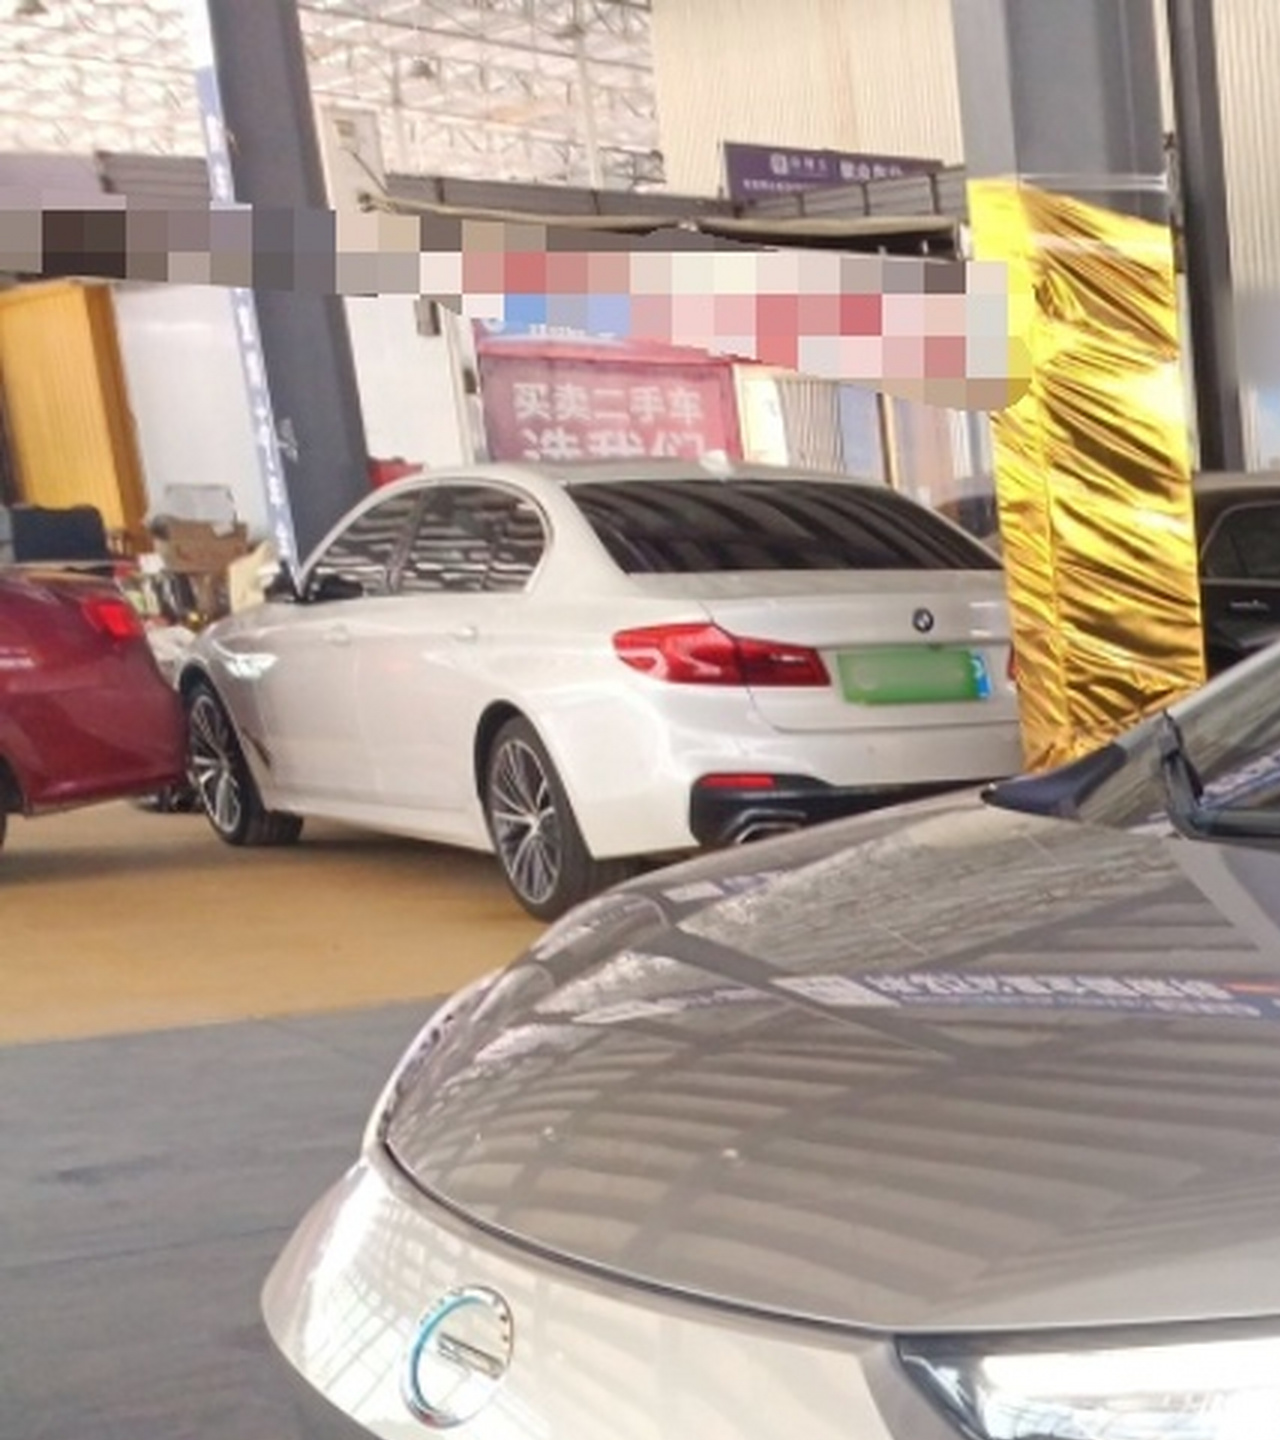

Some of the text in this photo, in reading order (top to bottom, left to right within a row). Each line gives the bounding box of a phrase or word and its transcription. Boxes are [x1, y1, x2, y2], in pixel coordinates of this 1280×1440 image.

[513, 382, 704, 425] 买卖二手车
